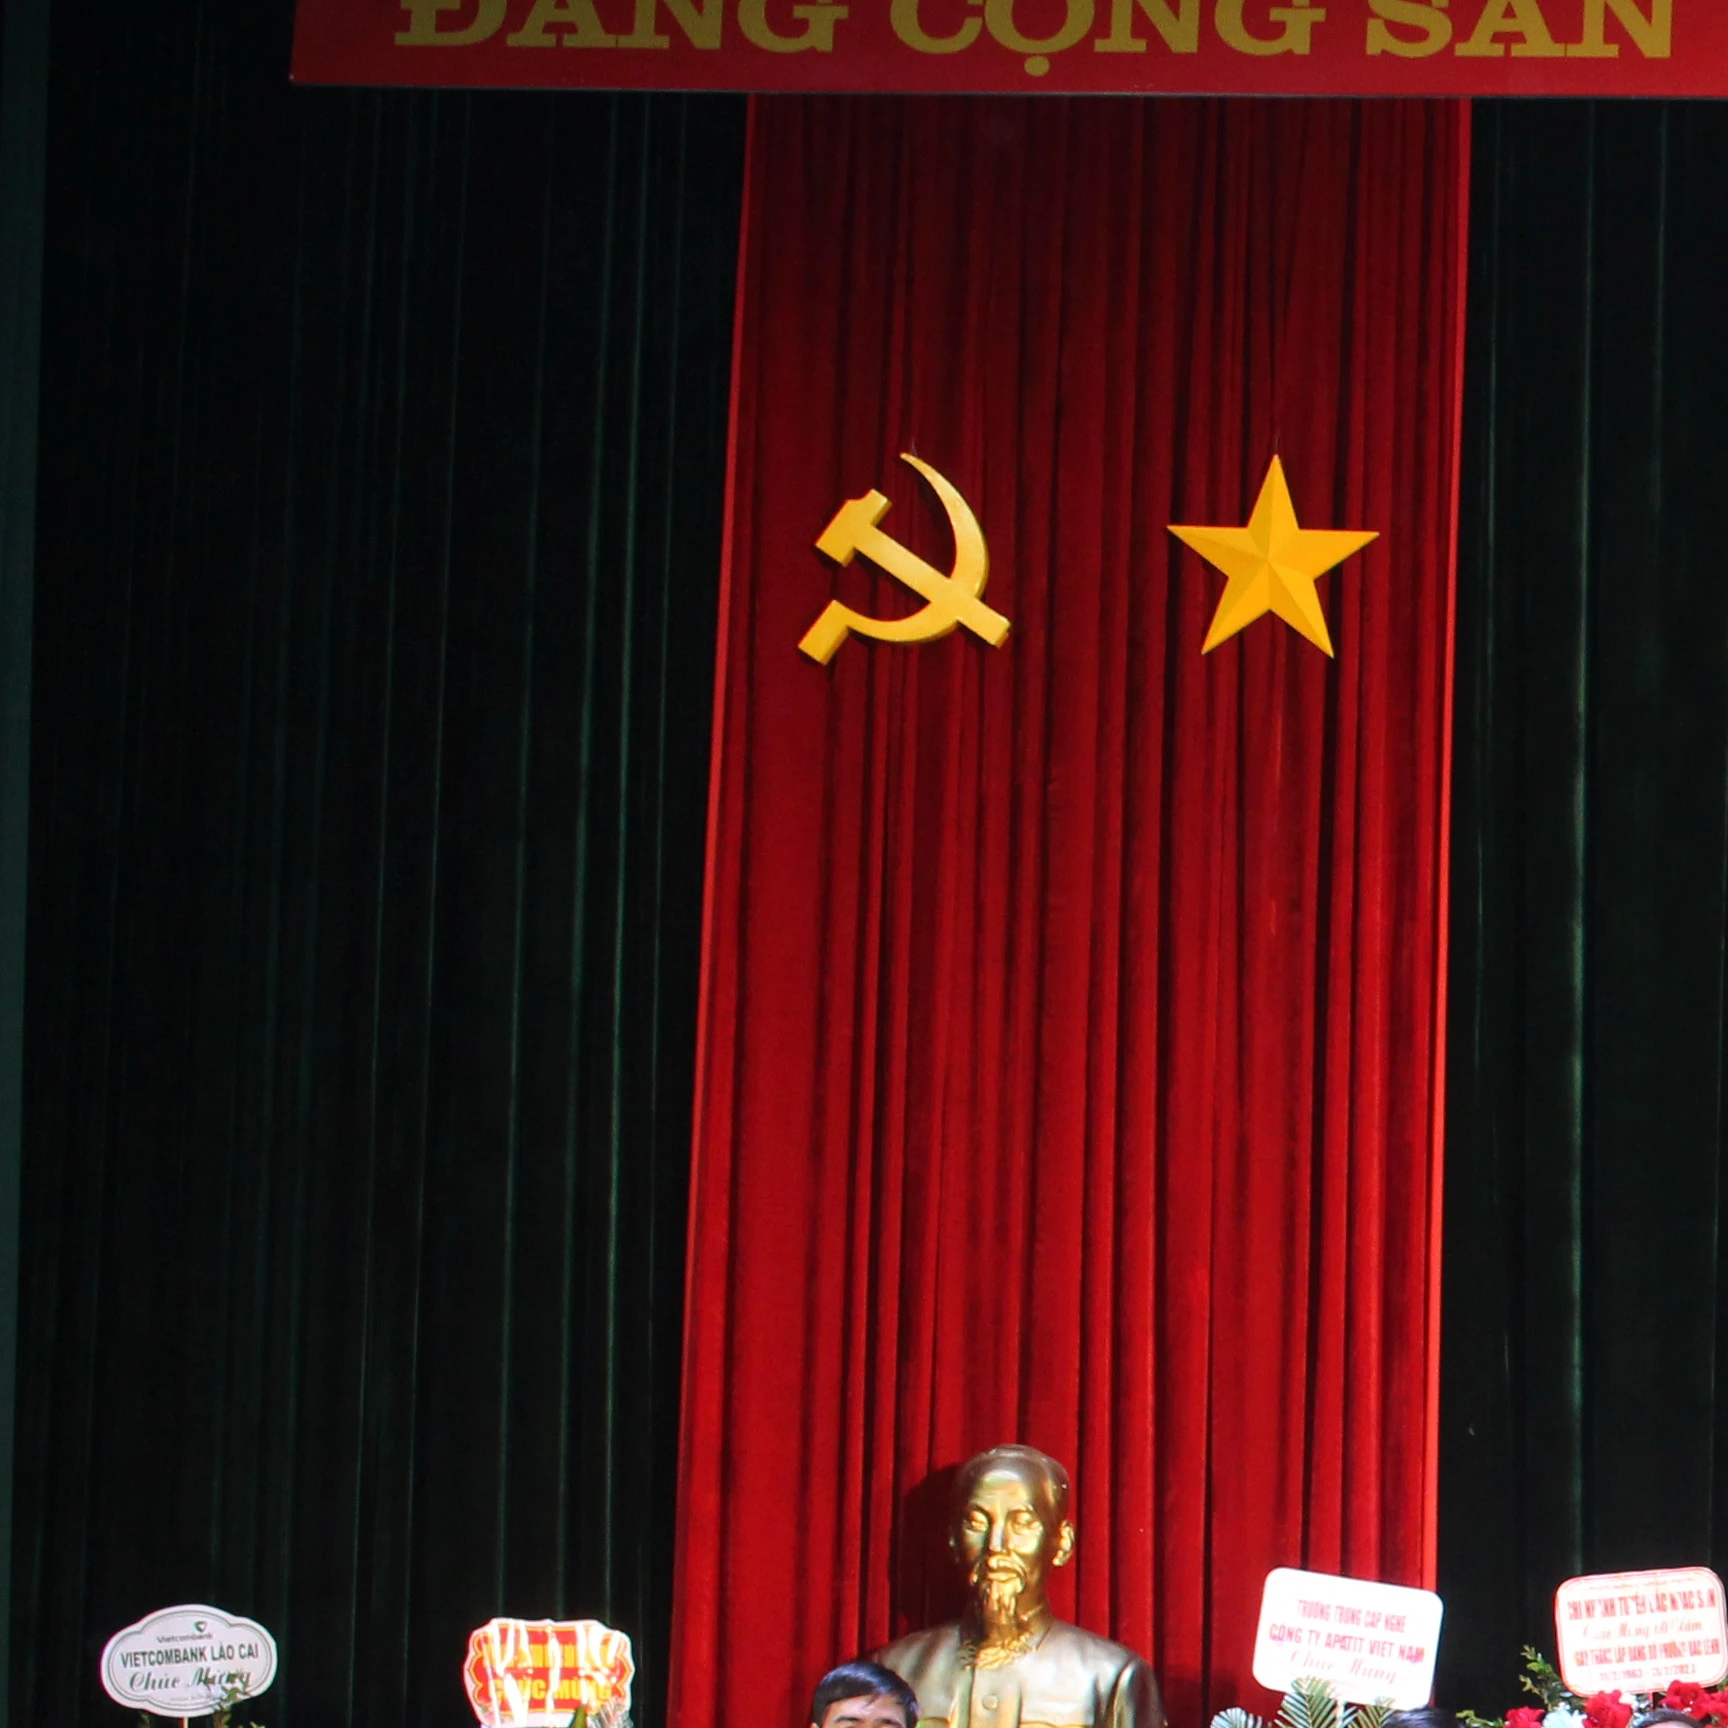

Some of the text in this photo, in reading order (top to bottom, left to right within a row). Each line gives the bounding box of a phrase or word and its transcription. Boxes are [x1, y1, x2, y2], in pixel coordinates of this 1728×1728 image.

[121, 1641, 260, 1668] VIETCOMBANK LÀO CAI
[1308, 1629, 1321, 1646] TY
[1398, 1644, 1425, 1664] NAM
[129, 1670, 181, 1692] Chúc
